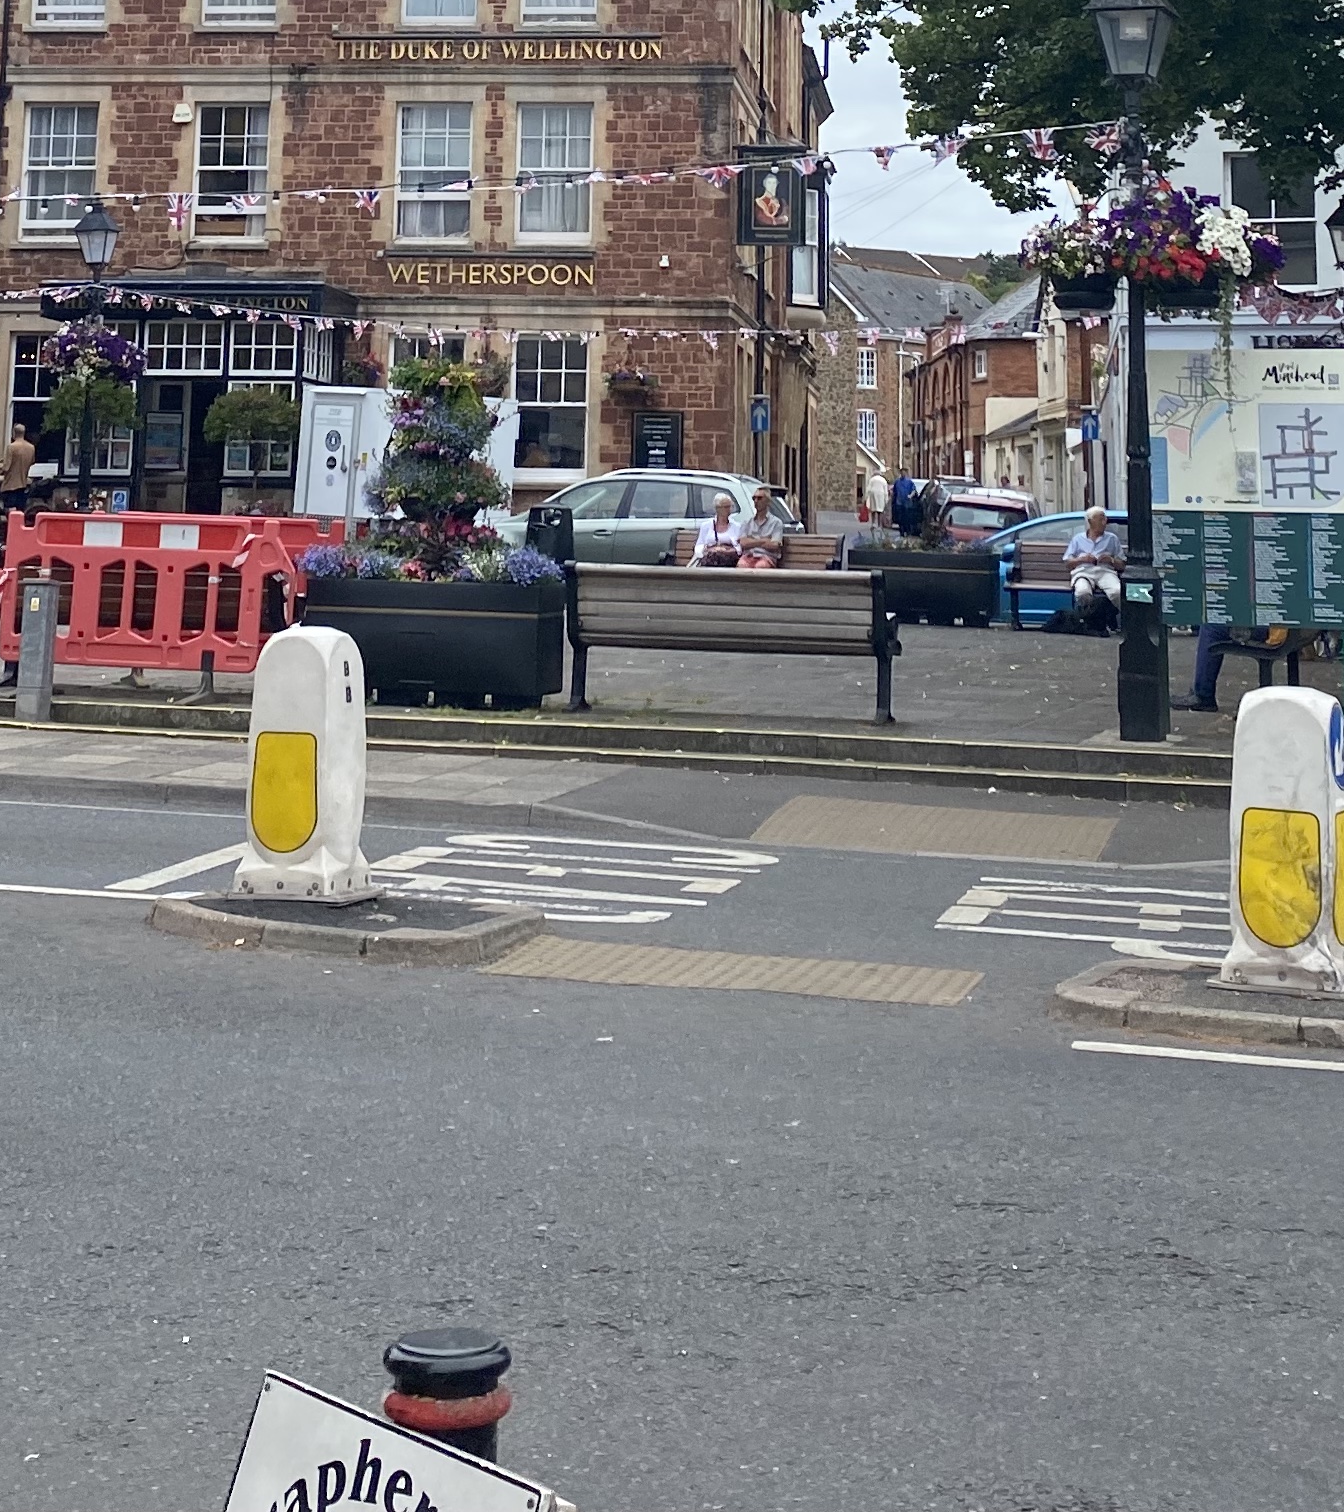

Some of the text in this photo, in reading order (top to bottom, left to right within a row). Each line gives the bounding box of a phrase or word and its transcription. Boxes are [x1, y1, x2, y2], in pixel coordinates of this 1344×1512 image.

[336, 40, 662, 60] THE DUKE OF WELLINGTON
[387, 262, 595, 286] WETHERSPOON
[1262, 364, 1325, 384] Minehead
